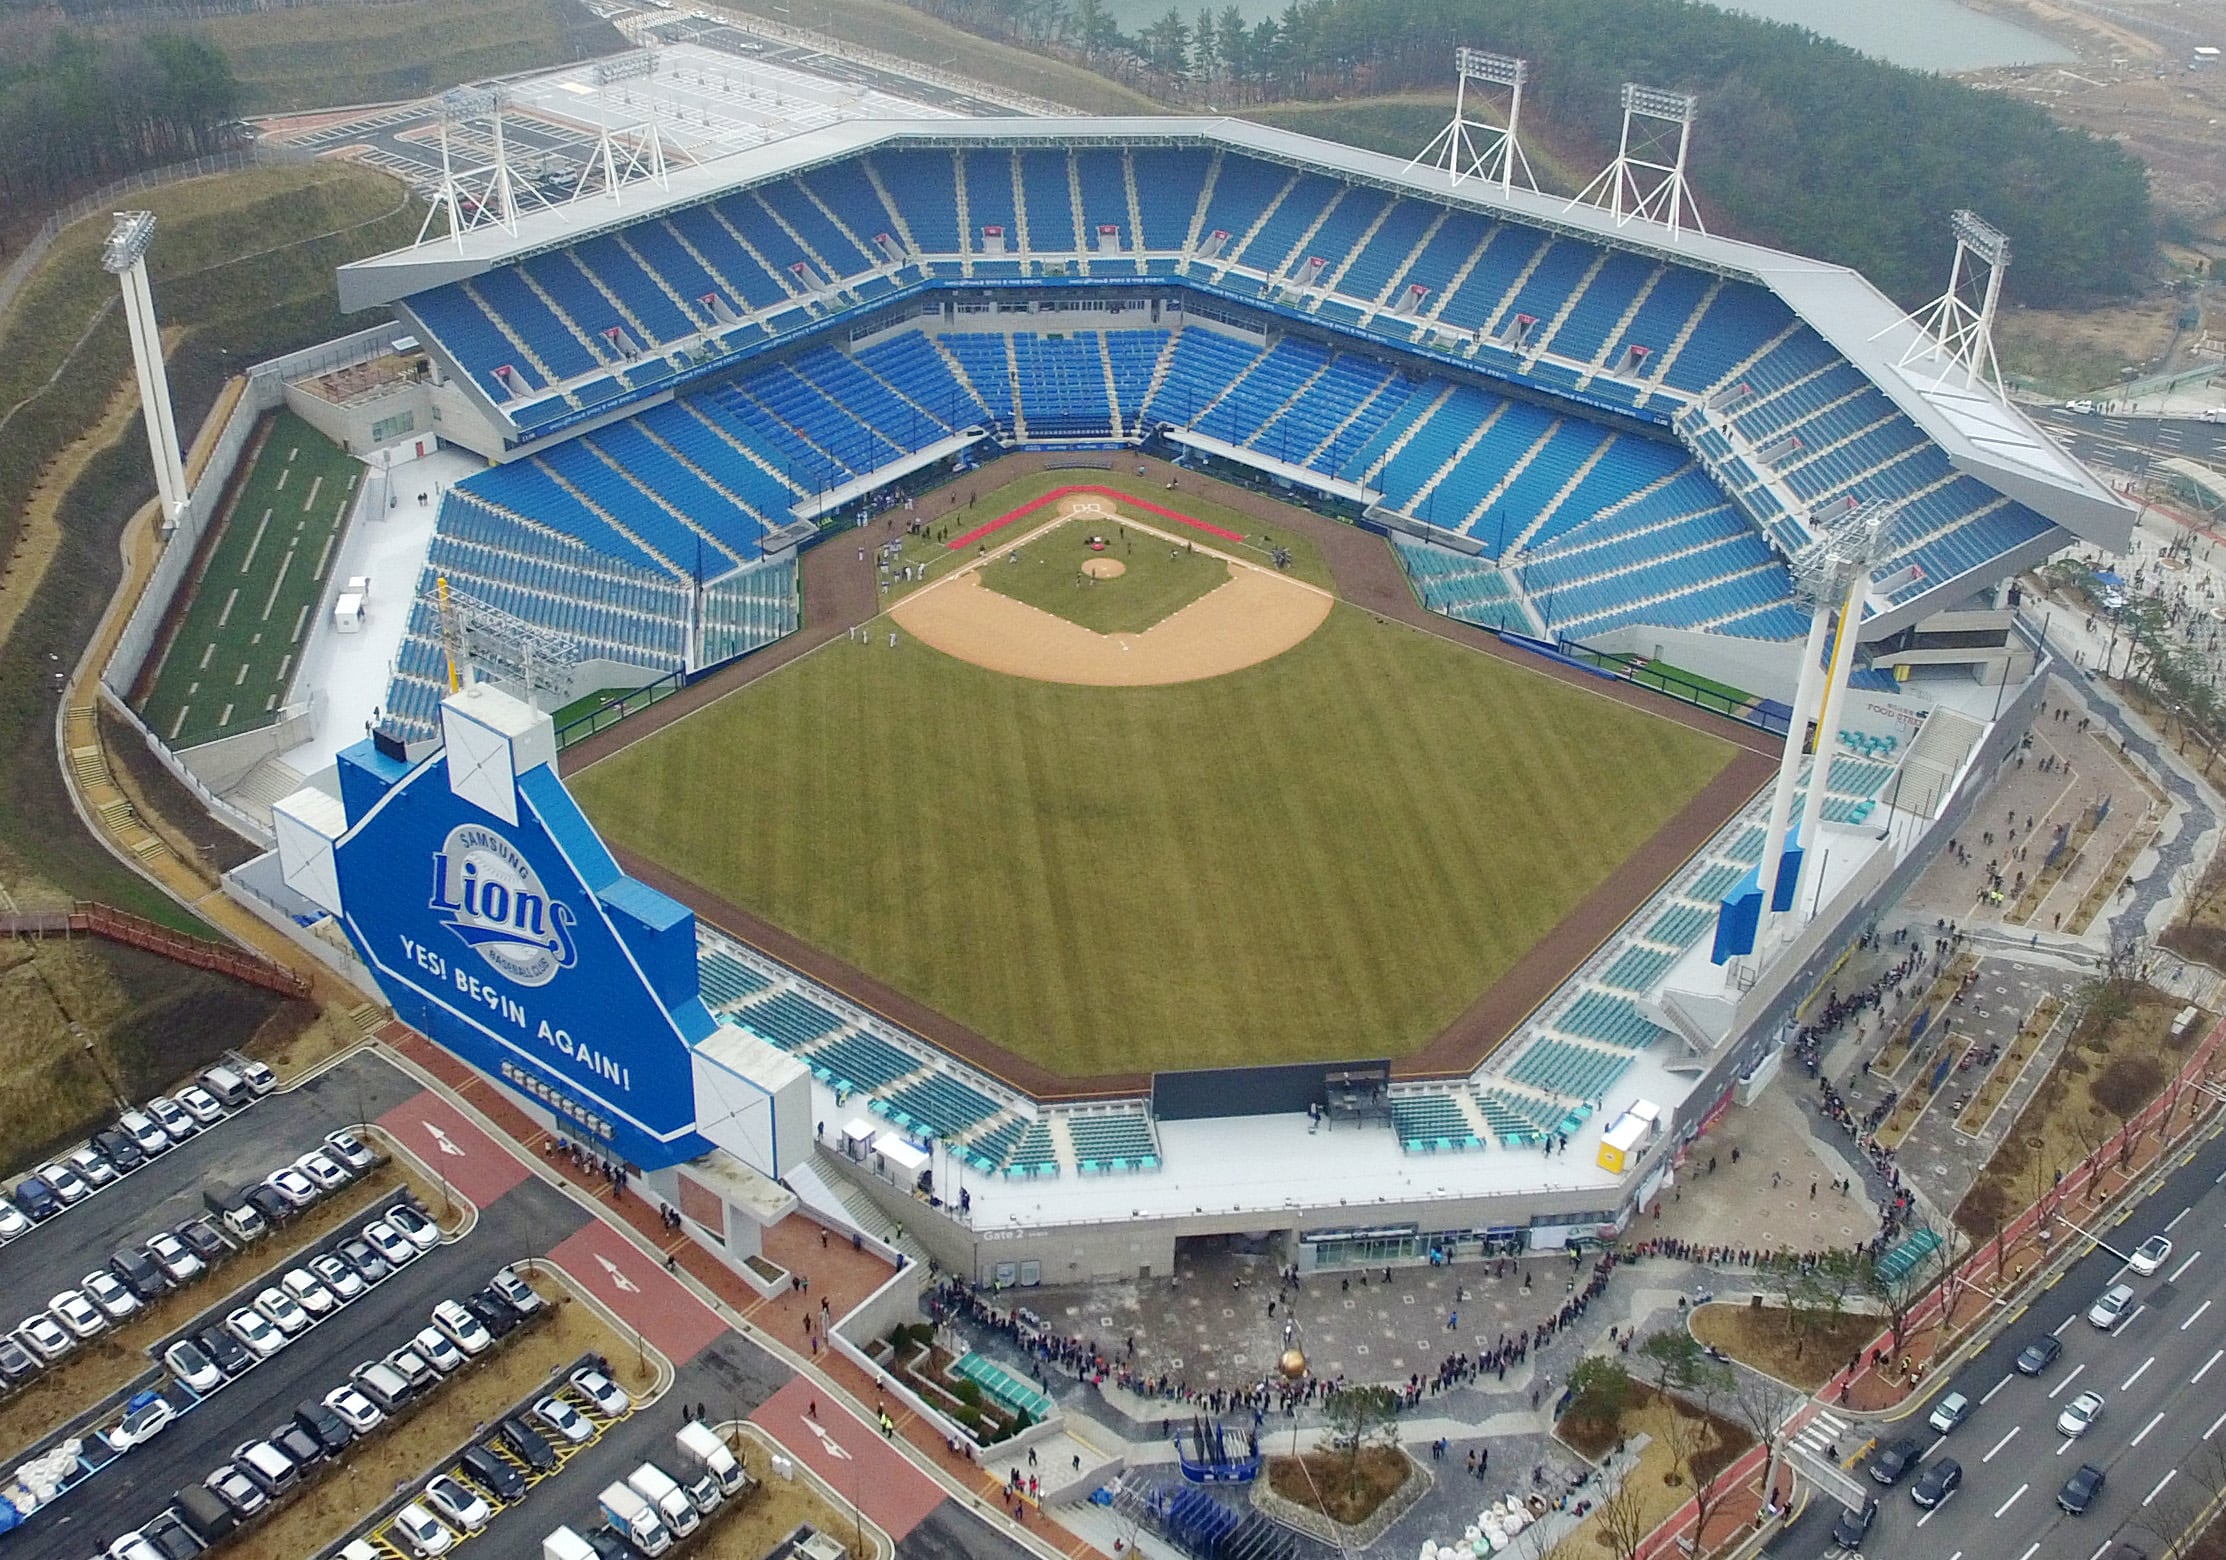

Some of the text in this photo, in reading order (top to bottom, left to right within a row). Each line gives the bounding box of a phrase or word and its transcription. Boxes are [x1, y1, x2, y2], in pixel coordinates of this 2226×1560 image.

[1867, 703, 1895, 718] FOOD
[460, 831, 529, 880] SAMSUNG
[429, 852, 578, 969] Lions
[400, 934, 630, 1091] YES! BEGIN AGAIN!
[983, 1230, 1013, 1241] Gate
[1015, 1229, 1025, 1239] 2
